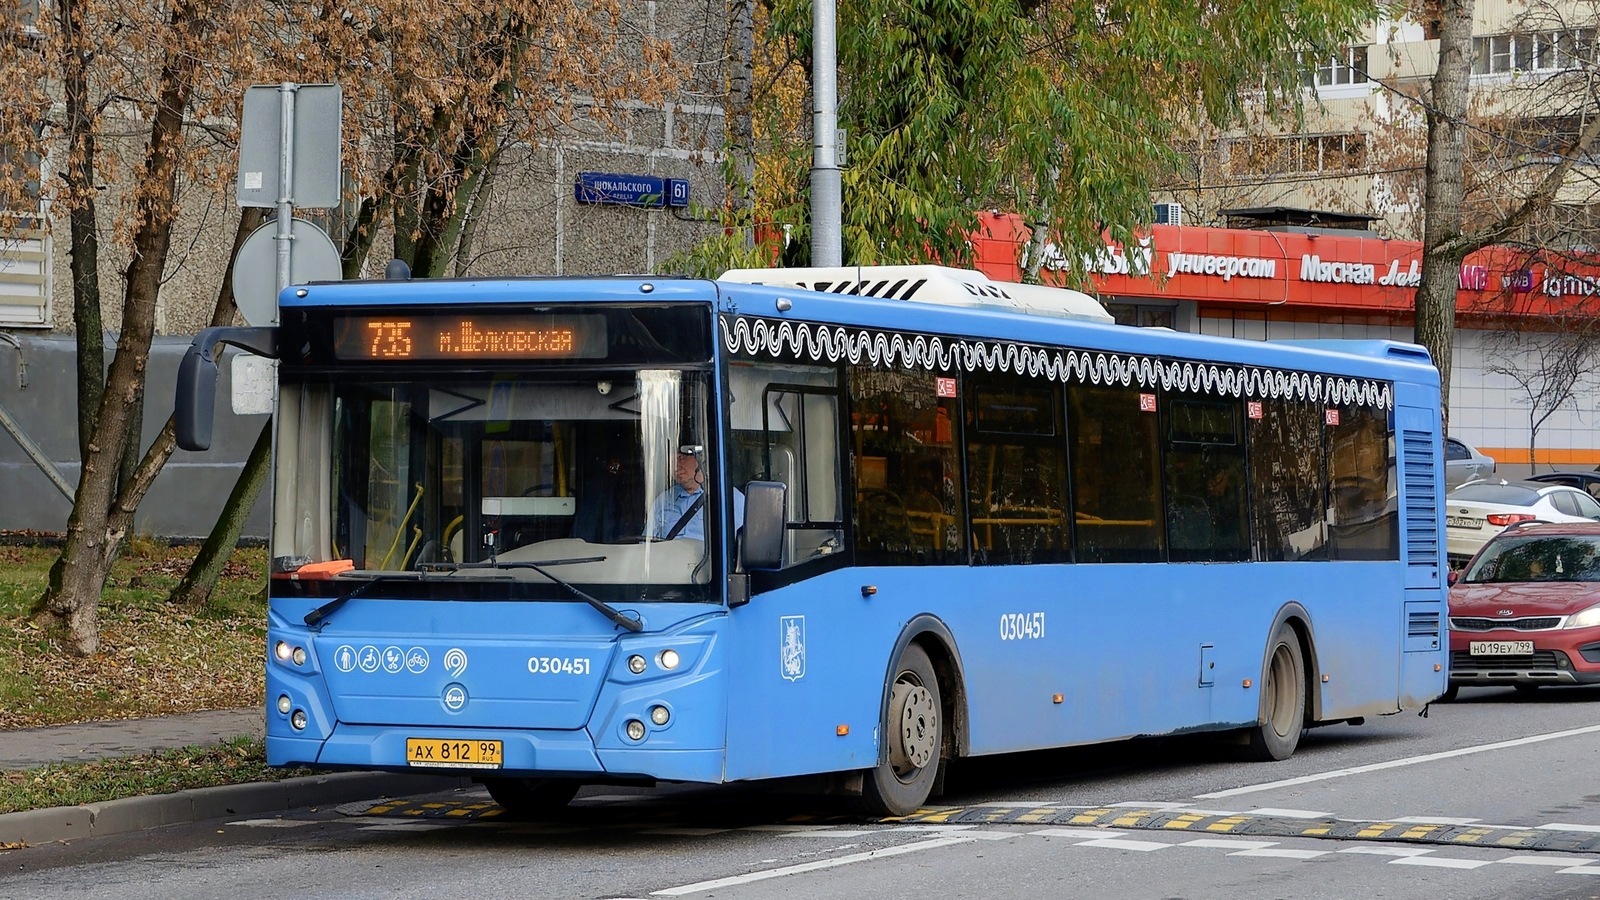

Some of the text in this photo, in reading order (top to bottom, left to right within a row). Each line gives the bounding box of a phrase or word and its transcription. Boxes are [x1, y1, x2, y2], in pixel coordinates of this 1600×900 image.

[594, 180, 652, 193] ШОКАЛЬСКОГО
[674, 183, 686, 198] 61
[1167, 252, 1276, 281] универсам
[1300, 254, 1375, 285] Мясная
[1542, 268, 1600, 296] lamo
[368, 322, 411, 356] 735
[1000, 612, 1045, 641] 030451
[1473, 643, 1512, 654] Н019ЕУ
[527, 657, 590, 675] 030451
[415, 742, 496, 760] АХ 812 99
